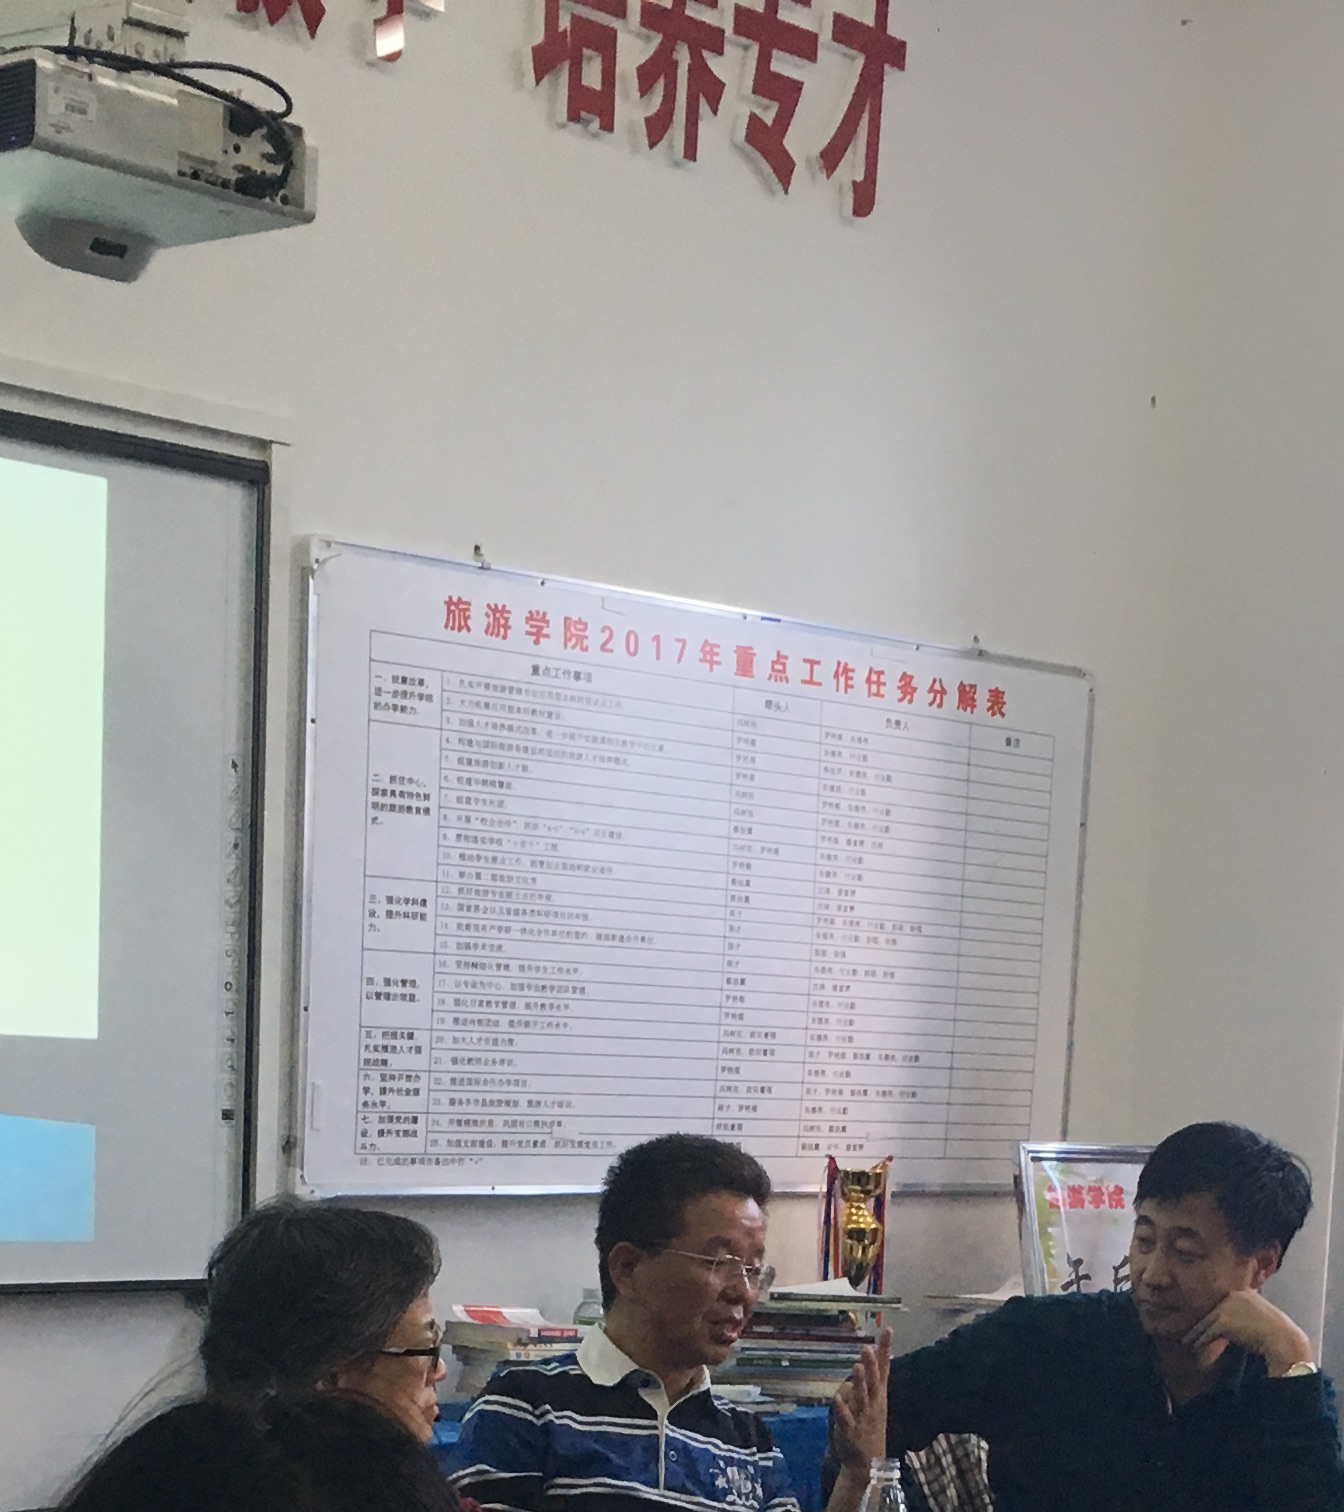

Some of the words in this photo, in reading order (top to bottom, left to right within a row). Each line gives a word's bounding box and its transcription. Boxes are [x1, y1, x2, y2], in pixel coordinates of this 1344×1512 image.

[442, 595, 1008, 719] 旅游学院2017年重点工作任务分解表
